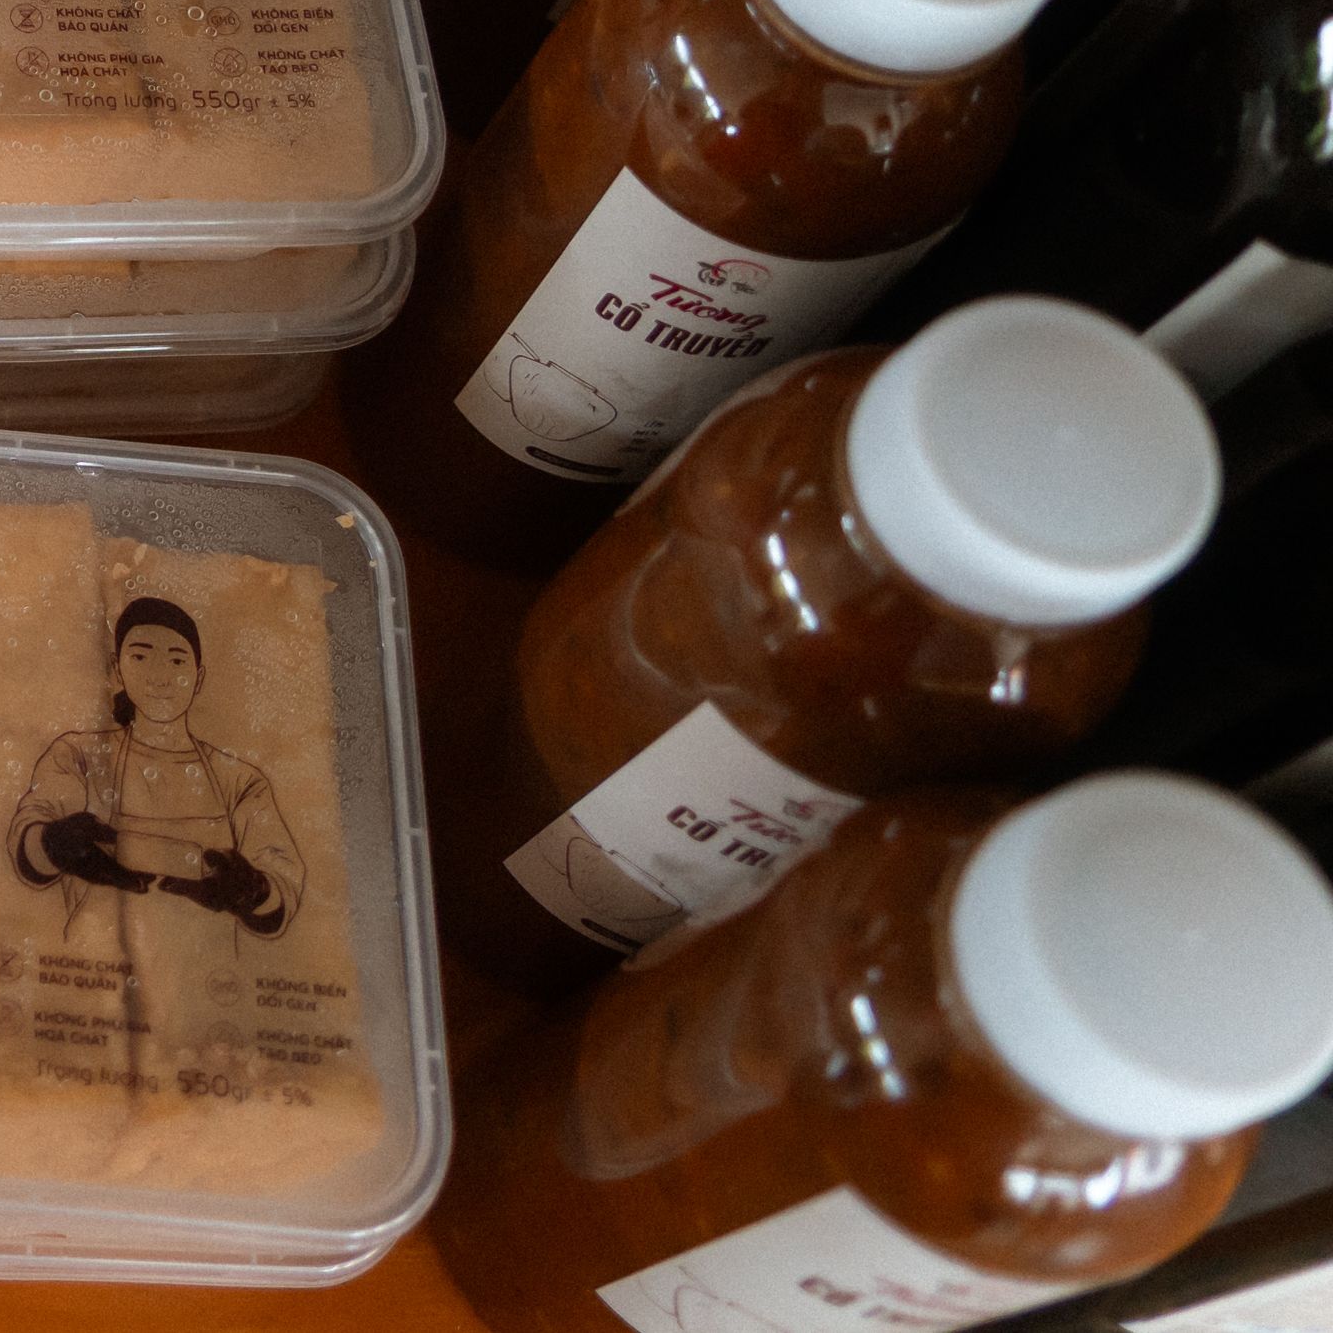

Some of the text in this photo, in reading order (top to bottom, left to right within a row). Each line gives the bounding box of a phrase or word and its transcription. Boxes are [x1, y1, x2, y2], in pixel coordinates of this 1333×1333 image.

[191, 90, 317, 113] 550gr 5%
[594, 291, 651, 332] CỔ
